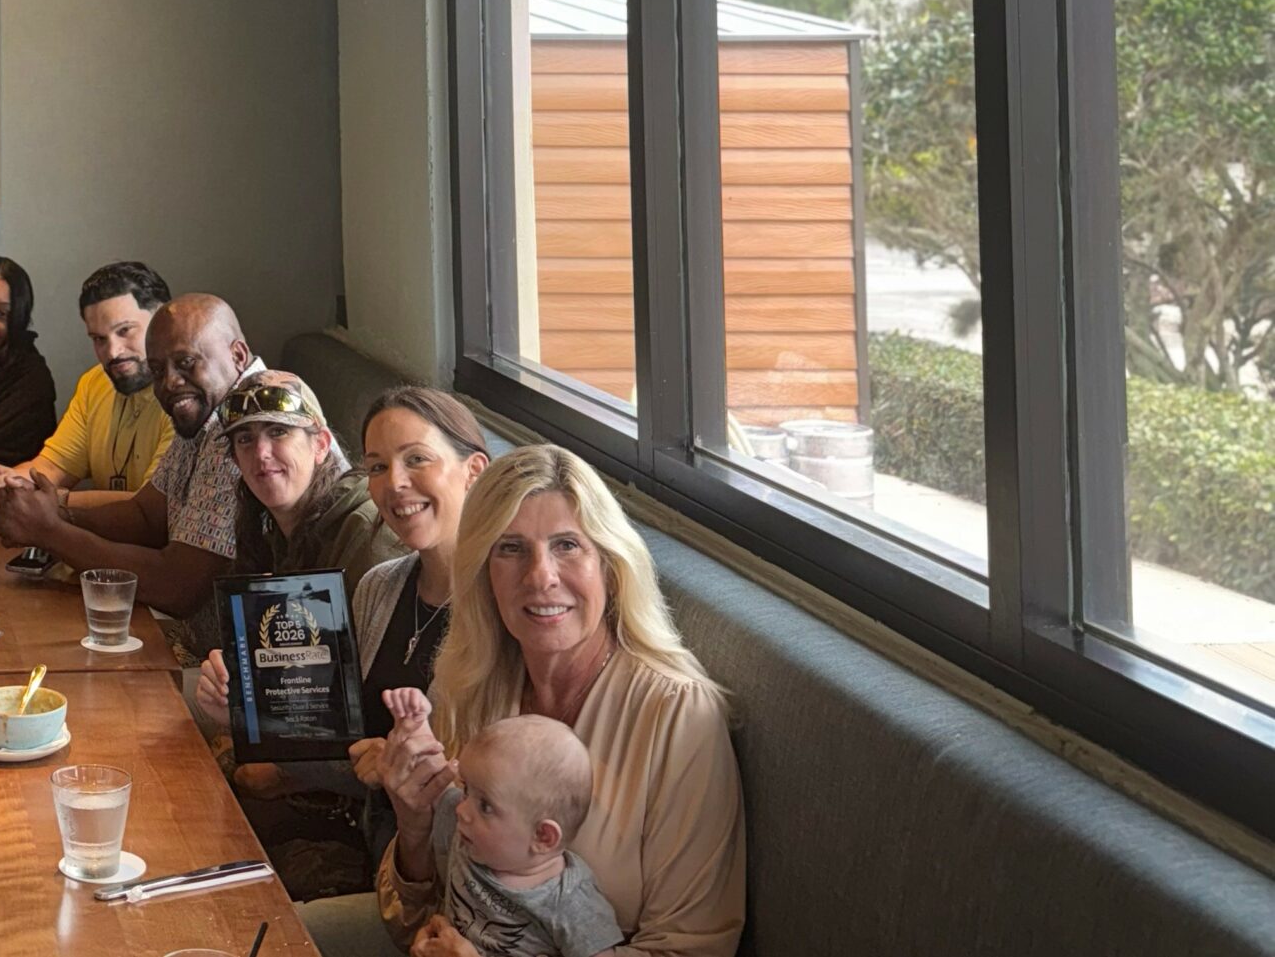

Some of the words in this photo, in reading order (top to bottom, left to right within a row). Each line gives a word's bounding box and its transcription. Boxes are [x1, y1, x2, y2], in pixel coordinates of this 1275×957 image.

[275, 620, 294, 630] TOP
[295, 620, 302, 629] 5
[274, 629, 305, 642] 2026
[238, 635, 253, 702] BENCHMARK
[280, 676, 312, 684] Frontline
[265, 687, 301, 696] Protective
[300, 685, 330, 694] Services
